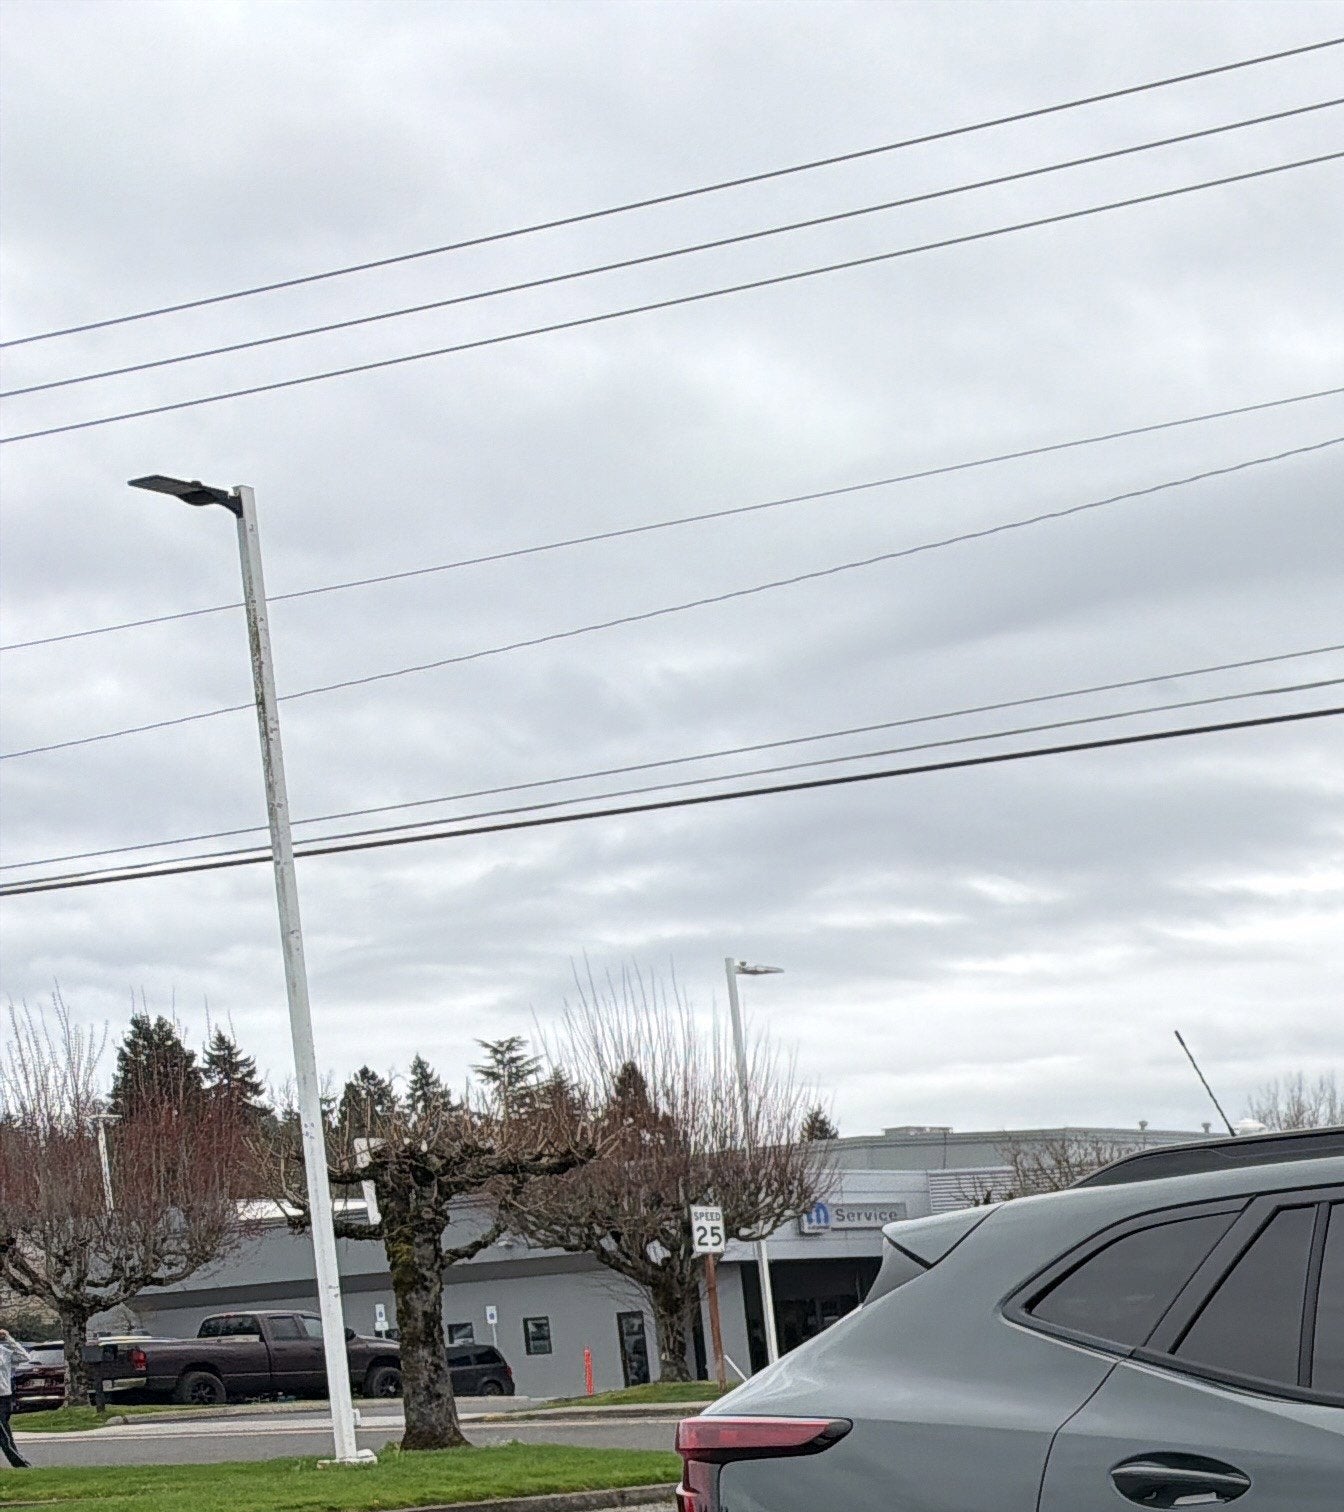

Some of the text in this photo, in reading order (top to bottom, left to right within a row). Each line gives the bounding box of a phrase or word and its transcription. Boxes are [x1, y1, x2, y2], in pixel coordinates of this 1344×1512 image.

[693, 1211, 721, 1221] SPEED
[835, 1208, 897, 1222] Service
[696, 1225, 723, 1246] 25
